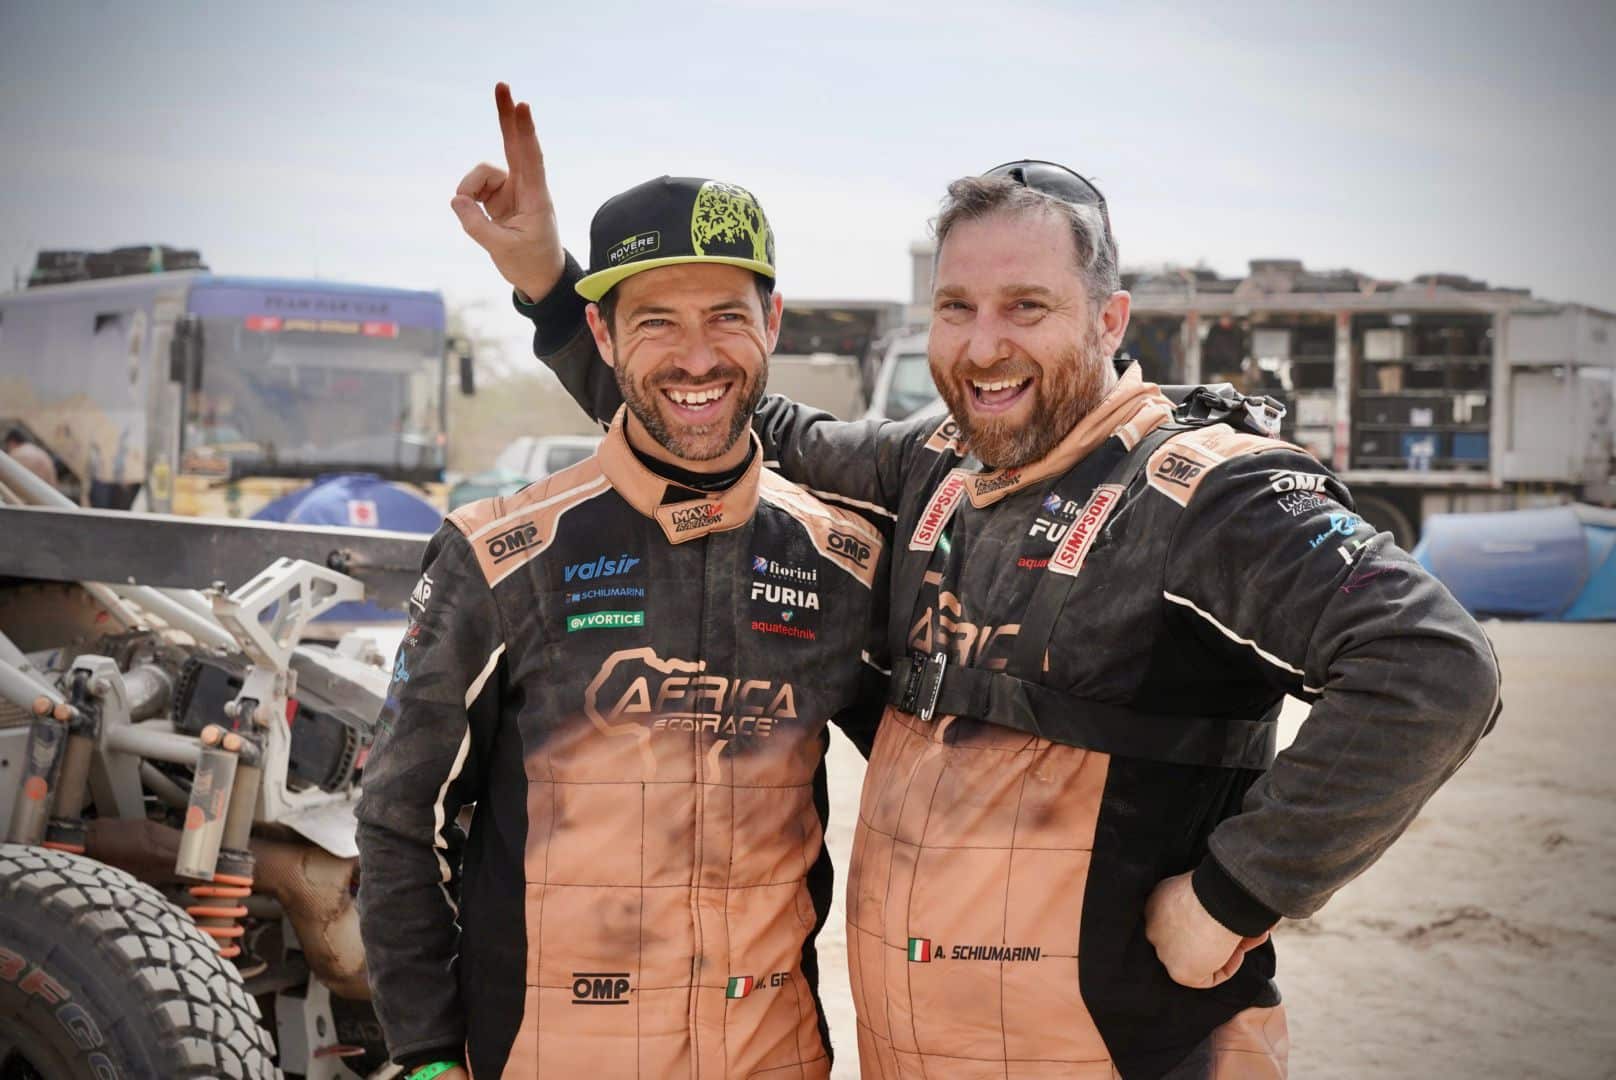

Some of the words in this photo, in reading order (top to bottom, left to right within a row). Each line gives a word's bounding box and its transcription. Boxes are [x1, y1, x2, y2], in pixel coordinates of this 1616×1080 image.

[610, 236, 655, 262] ROVERE
[1158, 457, 1202, 482] OMP
[918, 477, 965, 541] SIMPSON
[488, 526, 538, 558] OMP
[1060, 494, 1110, 565] SIMPSON
[827, 532, 871, 563] OMP
[564, 553, 641, 583] valsir
[769, 560, 818, 581] fiorini
[751, 581, 820, 611] FURIA
[587, 613, 642, 625] VORTICE
[751, 620, 817, 641] aquatechnik
[606, 675, 798, 721] AFRICA
[934, 945, 946, 959] A.
[950, 944, 1041, 962] SCHIUMARINI
[572, 978, 630, 1000] OMP
